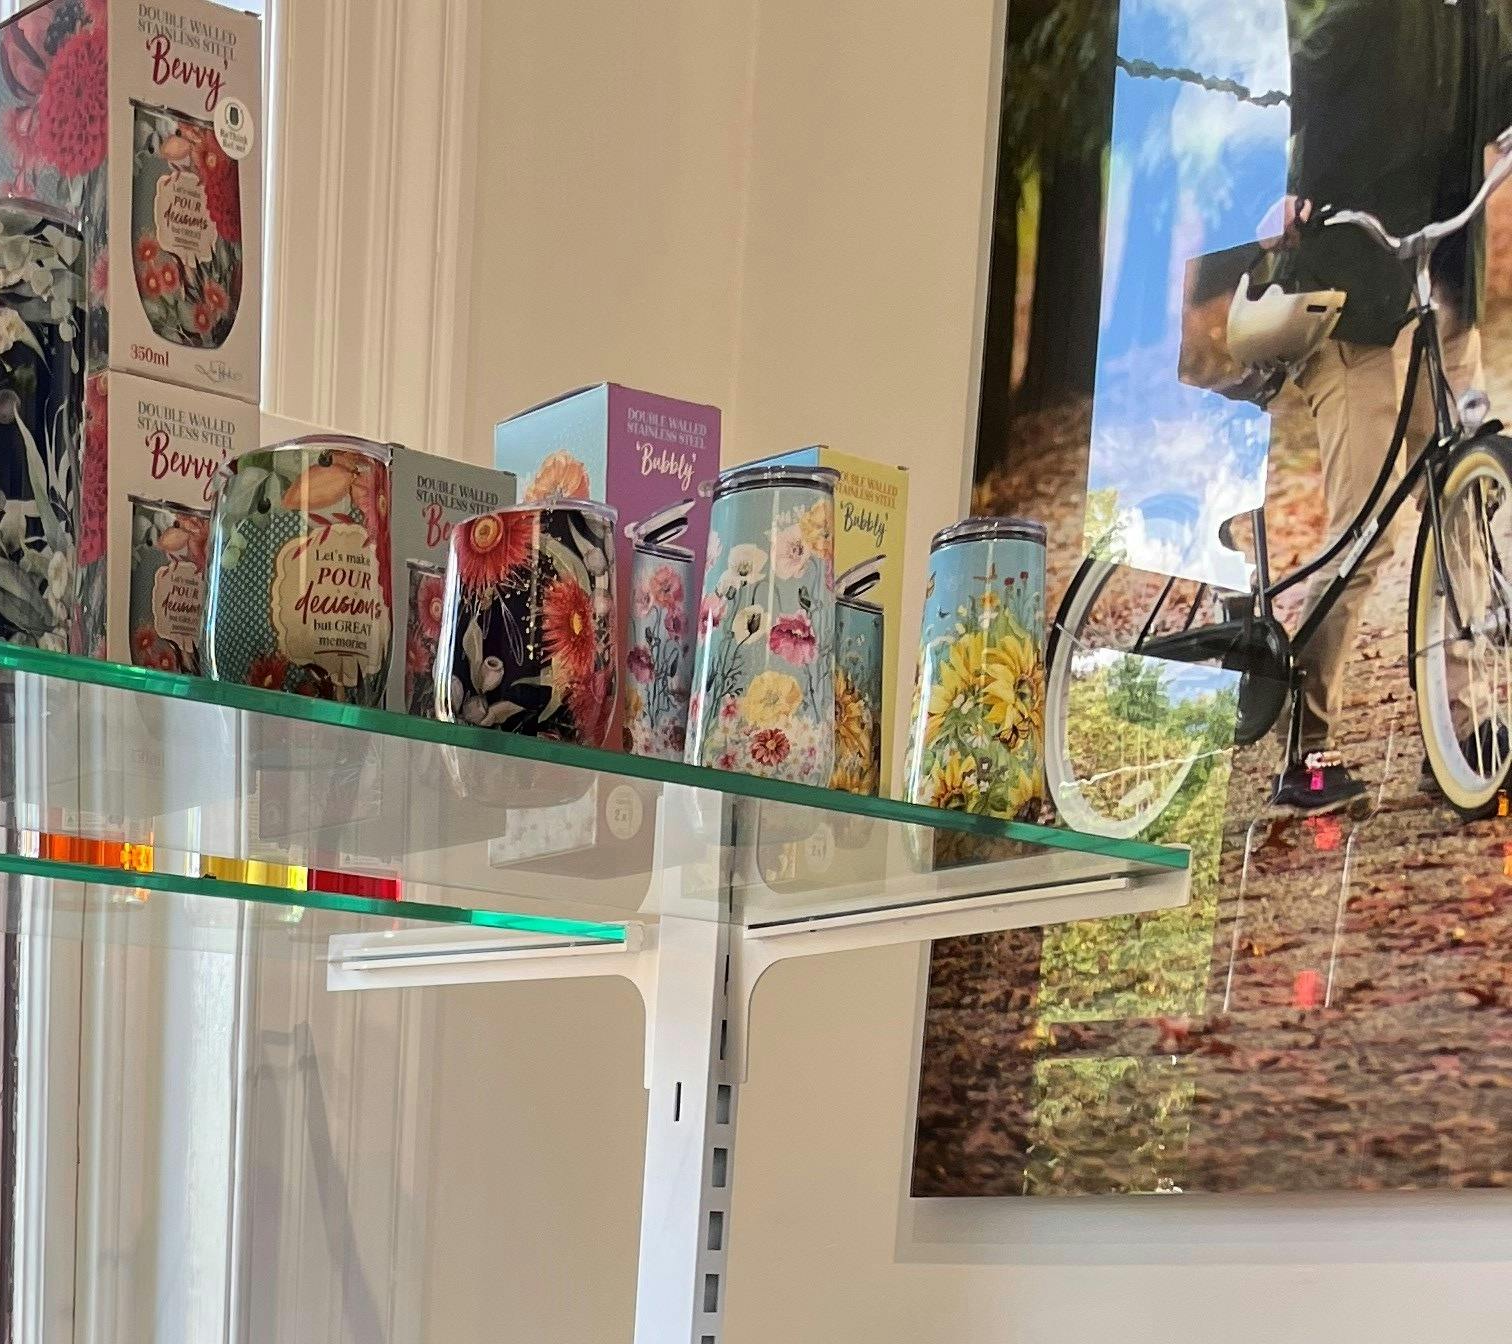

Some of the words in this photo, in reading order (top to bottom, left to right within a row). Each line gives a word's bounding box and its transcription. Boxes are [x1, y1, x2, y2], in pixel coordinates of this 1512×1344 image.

[130, 342, 170, 367] 350ml
[315, 549, 343, 563] Let's
[346, 553, 371, 566] make
[317, 567, 371, 590] POUR
[295, 580, 382, 625] decisions
[313, 618, 332, 632] but
[334, 619, 372, 635] GREAT
[319, 636, 367, 650] memories
